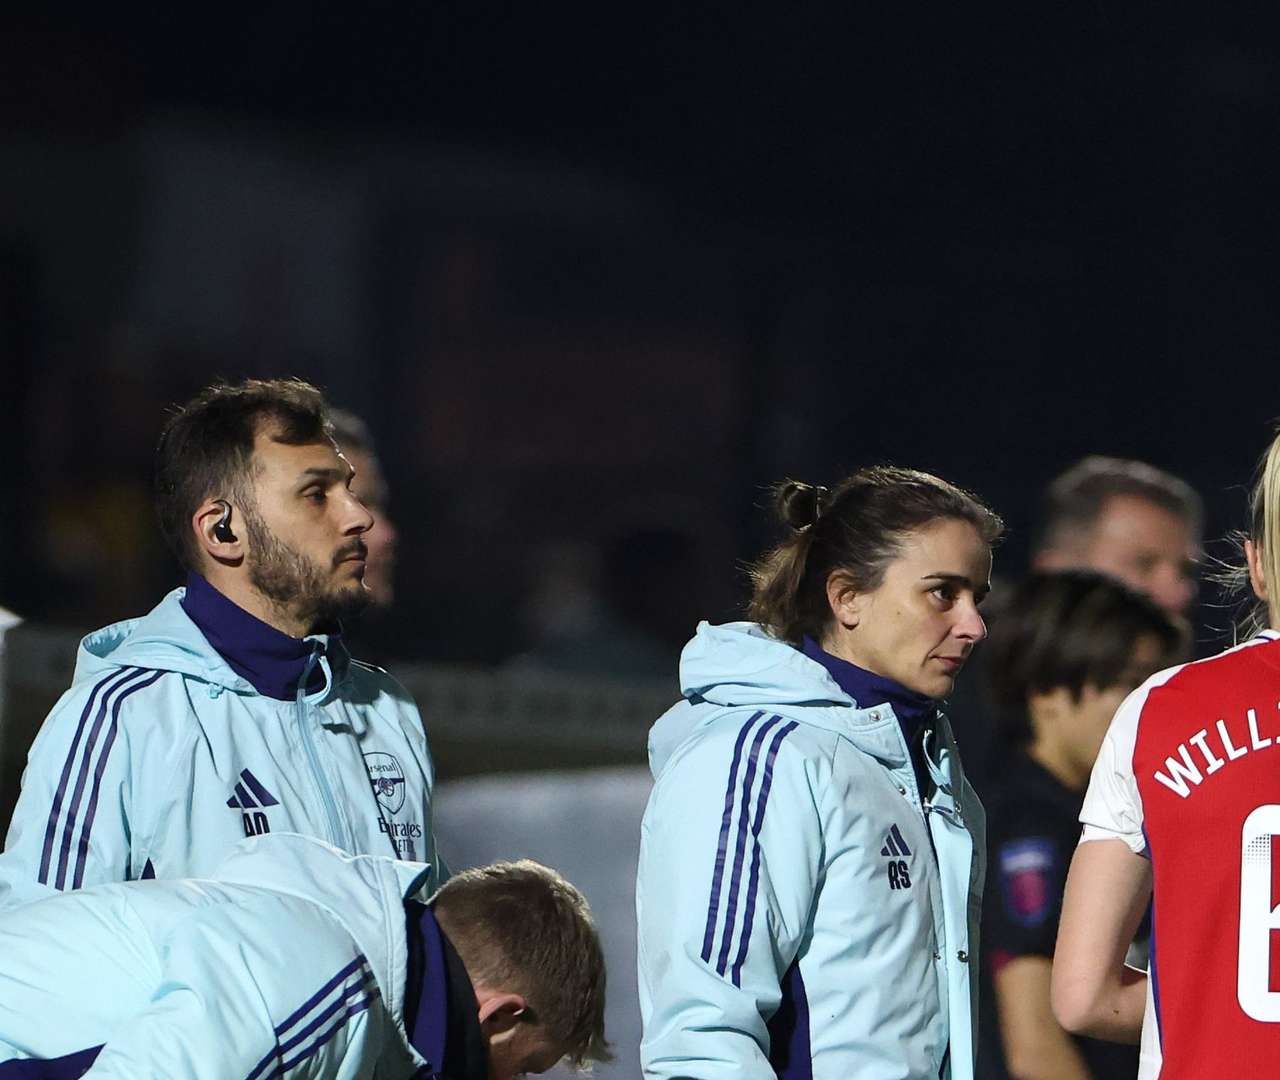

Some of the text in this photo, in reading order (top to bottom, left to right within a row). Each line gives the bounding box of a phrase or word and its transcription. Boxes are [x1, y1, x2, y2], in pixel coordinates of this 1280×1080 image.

[368, 762, 397, 774] rsenal
[377, 816, 422, 838] Eirates
[888, 860, 912, 890] RS
